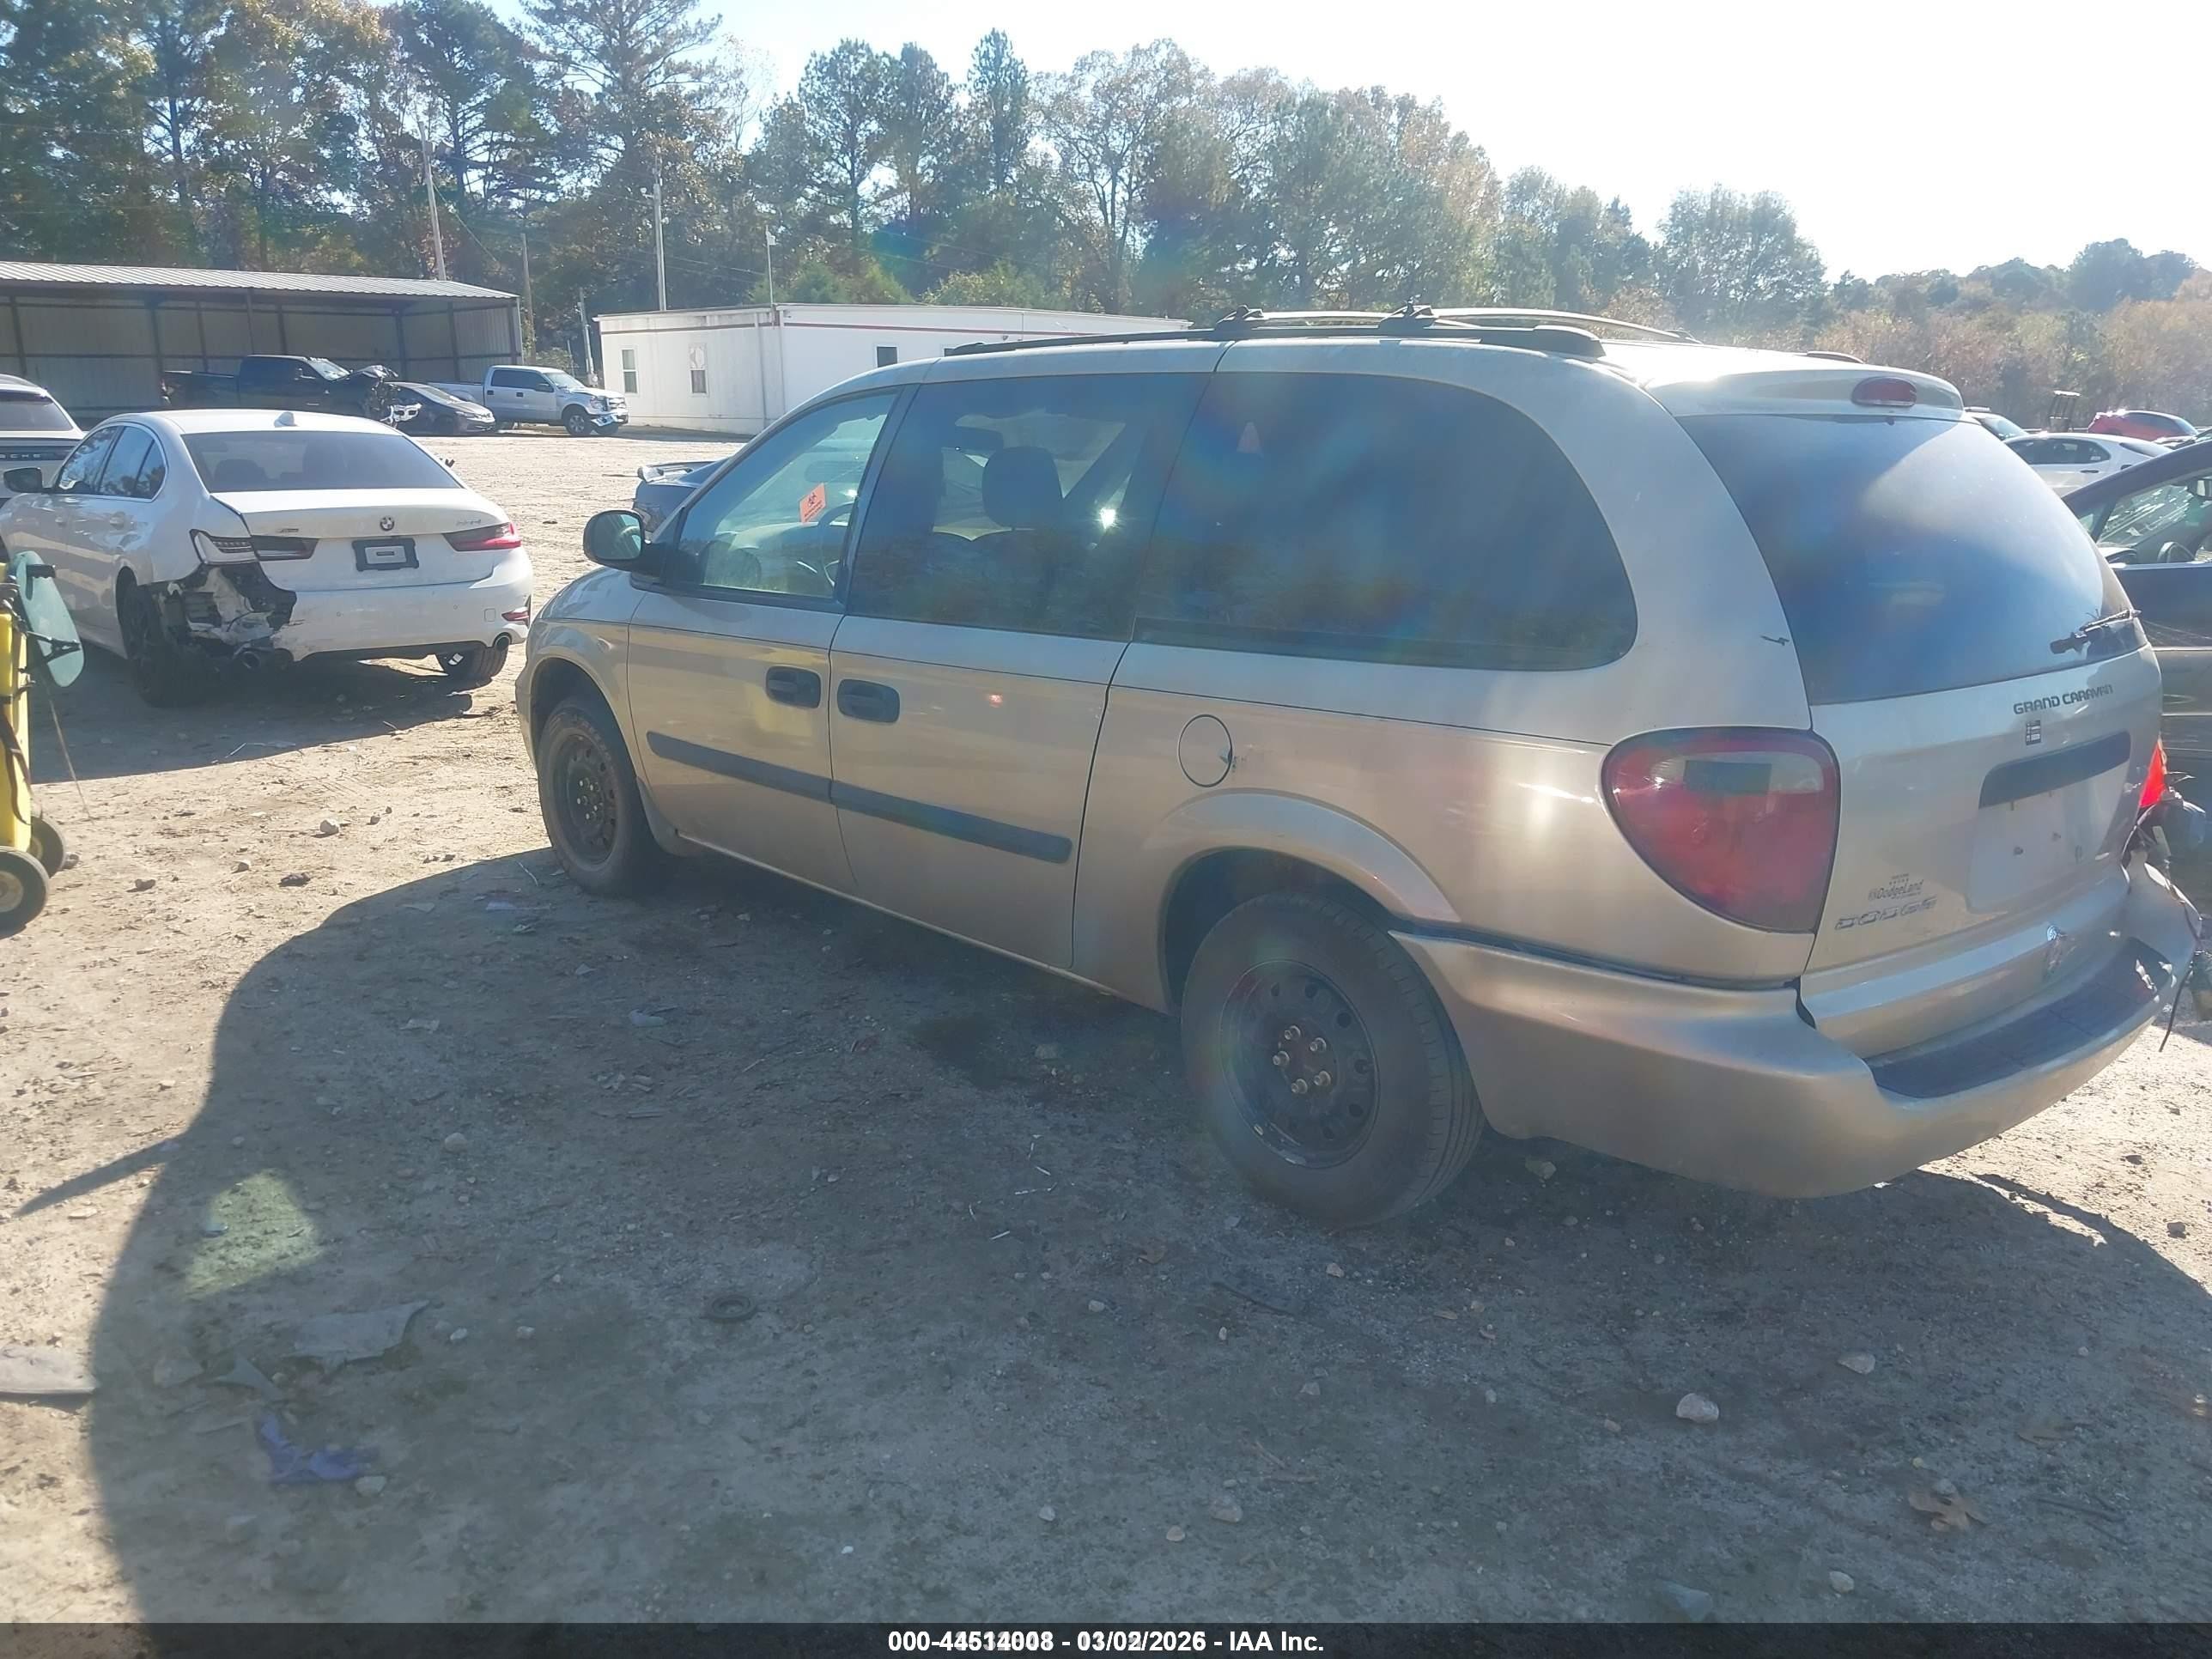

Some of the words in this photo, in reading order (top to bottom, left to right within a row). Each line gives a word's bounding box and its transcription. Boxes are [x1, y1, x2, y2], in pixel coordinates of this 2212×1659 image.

[2013, 696, 2060, 714] GRAND
[2062, 684, 2113, 705] CARAVAN
[1834, 895, 1937, 930] DODGE
